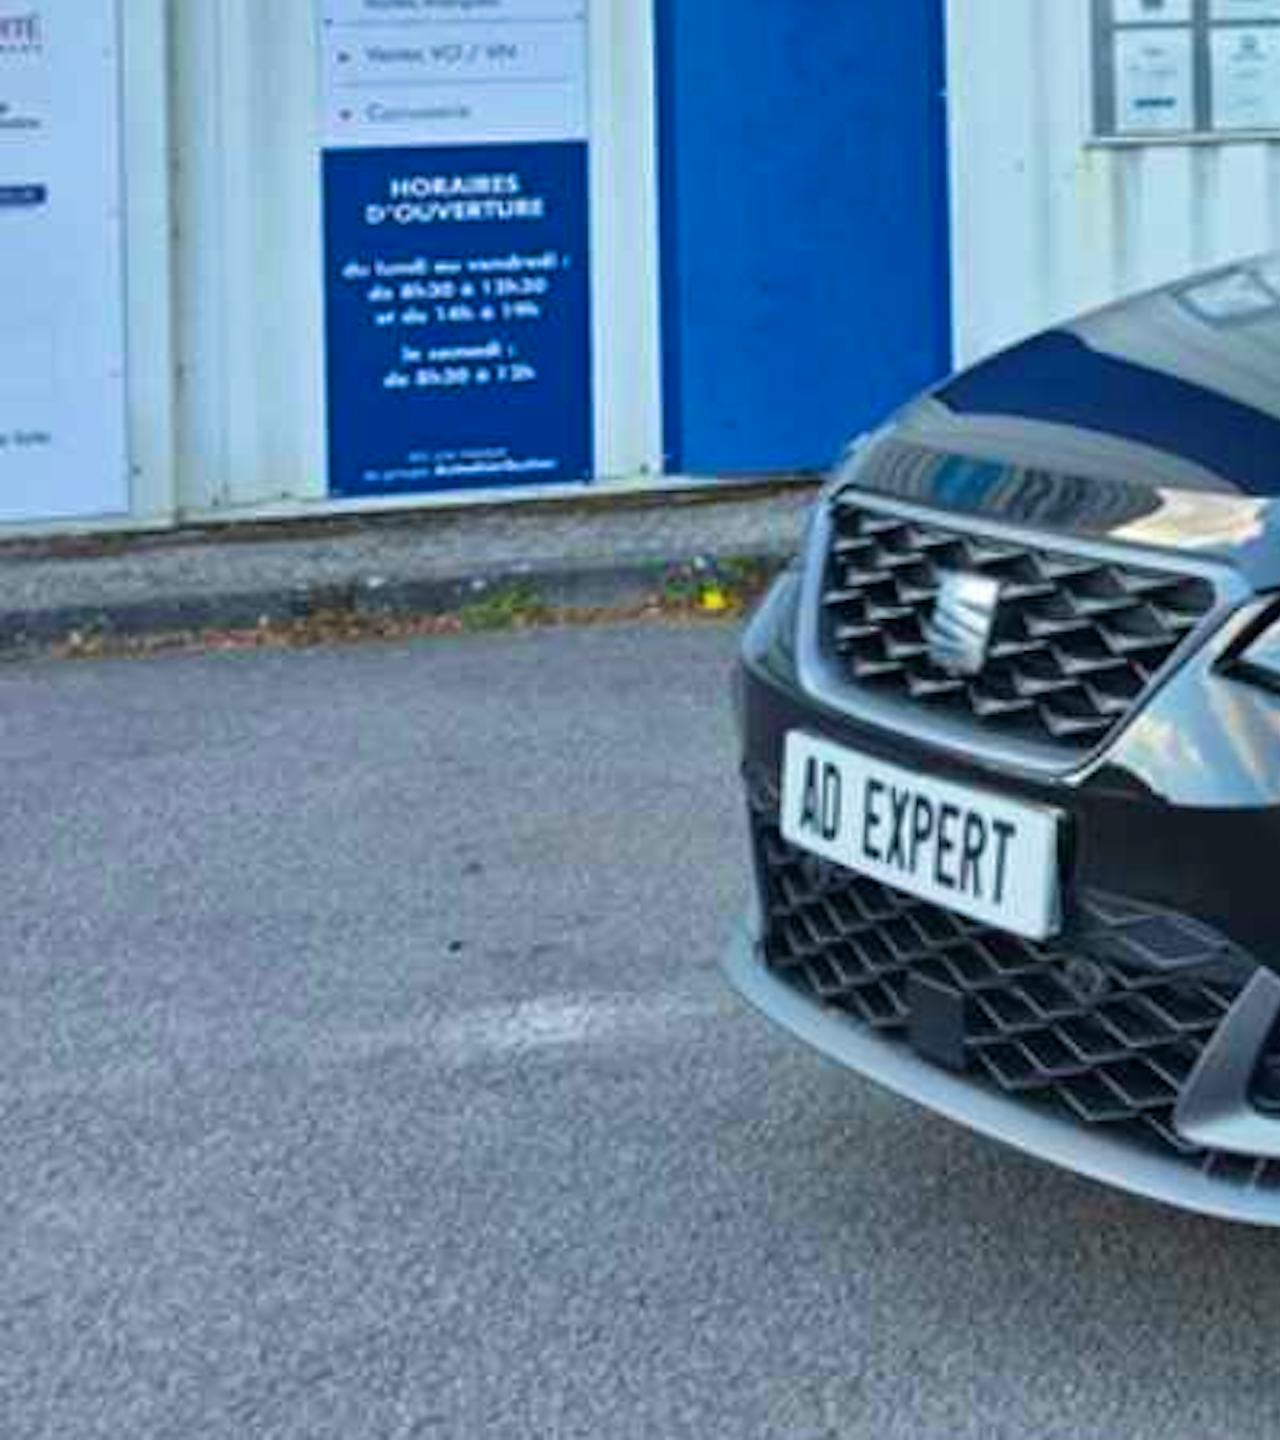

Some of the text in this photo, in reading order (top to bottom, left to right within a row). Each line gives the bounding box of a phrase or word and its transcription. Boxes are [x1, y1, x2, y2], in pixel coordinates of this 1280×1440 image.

[390, 173, 519, 199] HORAIRES
[365, 197, 545, 226] D'OUVERTURE
[800, 754, 1016, 905] AD EXPERT
